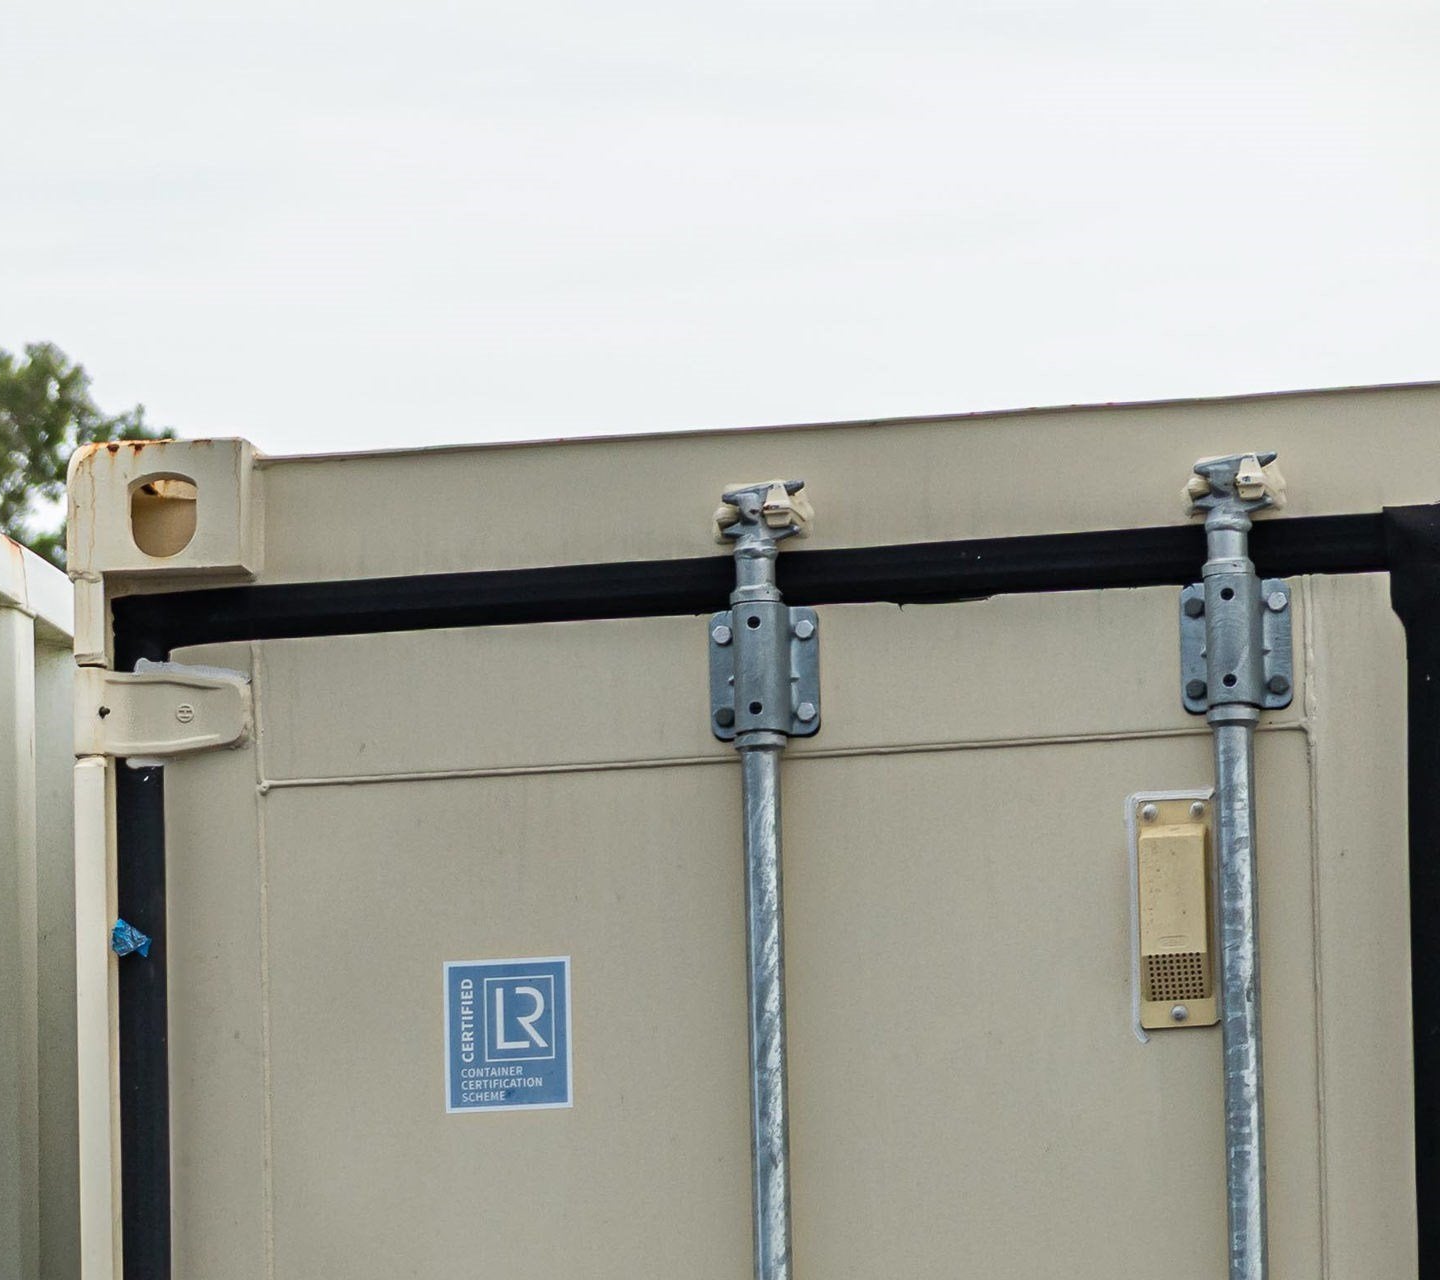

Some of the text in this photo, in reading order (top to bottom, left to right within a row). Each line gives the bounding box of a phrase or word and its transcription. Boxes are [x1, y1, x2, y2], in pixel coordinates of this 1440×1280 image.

[461, 978, 474, 1063] CERTIFIED
[461, 1066, 523, 1079] CONTAINER
[461, 1077, 543, 1090] CERTIFICATION
[461, 1090, 506, 1103] SCHEME
